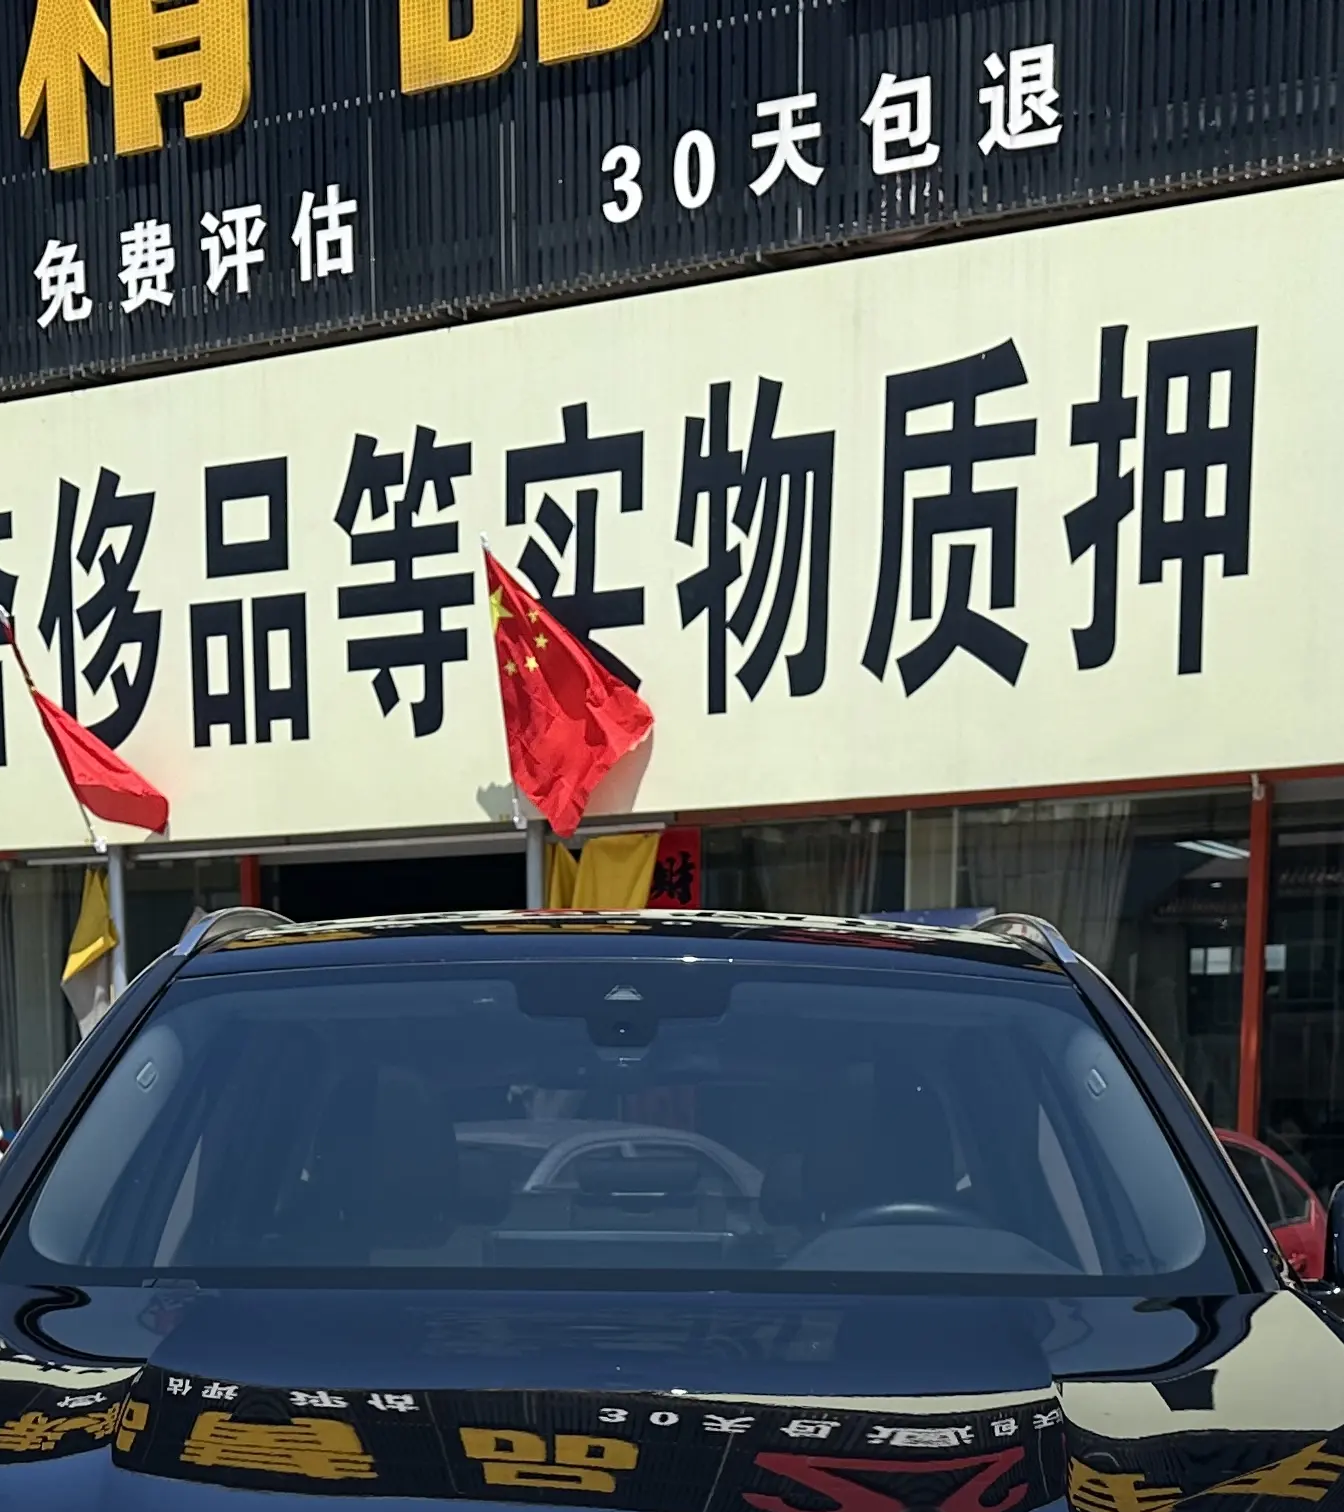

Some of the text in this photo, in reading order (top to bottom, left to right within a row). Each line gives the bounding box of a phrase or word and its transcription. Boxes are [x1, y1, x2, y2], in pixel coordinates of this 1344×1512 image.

[601, 43, 1063, 224] 30天包退
[33, 184, 357, 329] 免费评估
